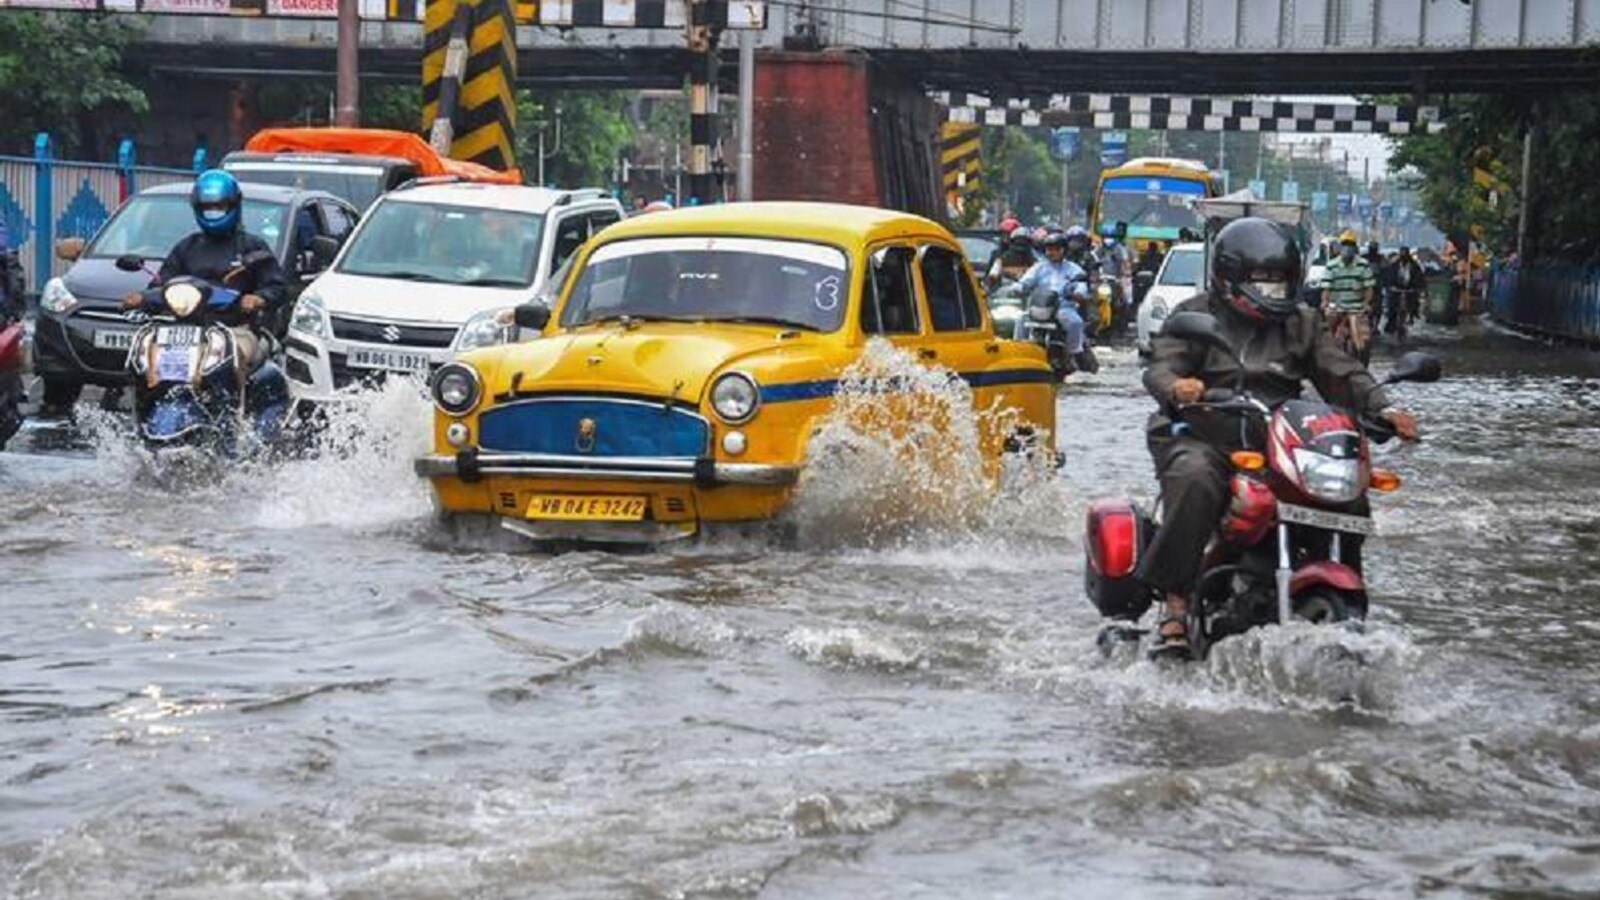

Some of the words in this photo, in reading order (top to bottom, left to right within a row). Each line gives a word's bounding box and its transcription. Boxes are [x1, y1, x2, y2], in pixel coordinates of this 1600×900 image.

[282, 0, 334, 10] DANGER
[540, 499, 561, 513] WB
[564, 499, 585, 514] 04
[587, 500, 599, 515] E
[601, 500, 642, 516] 3242
